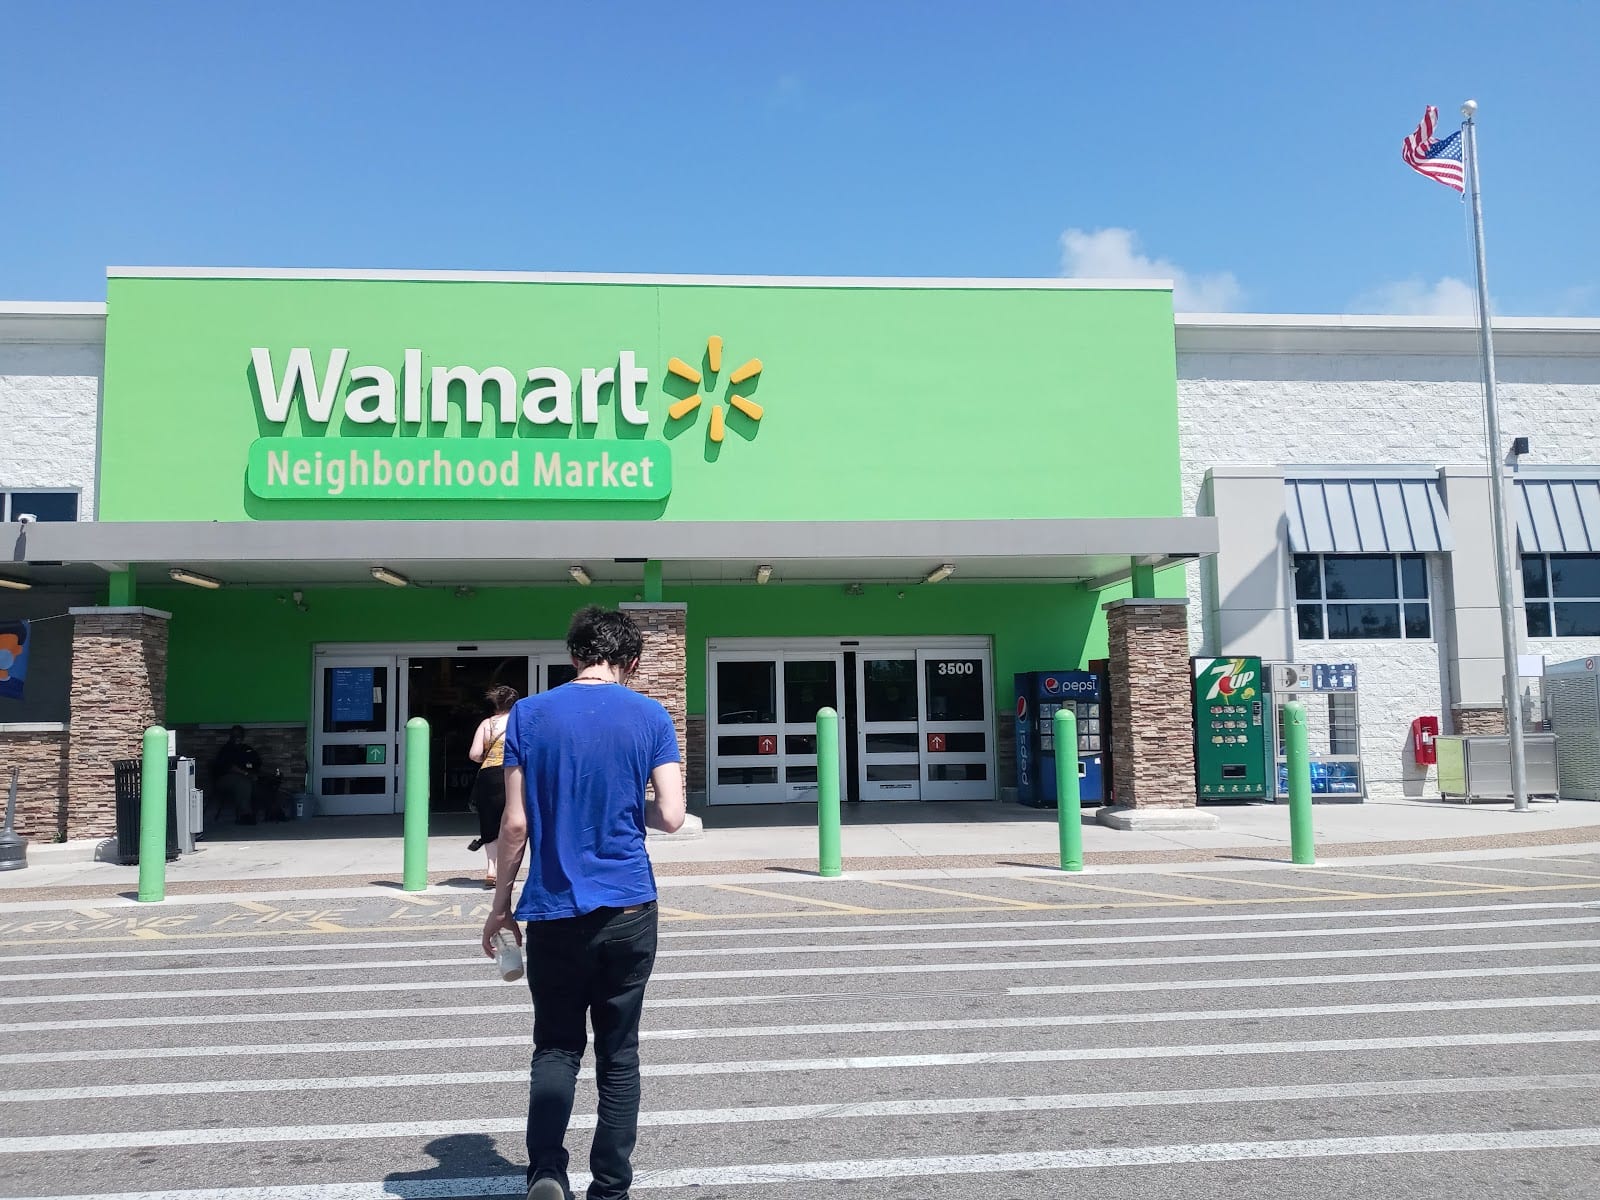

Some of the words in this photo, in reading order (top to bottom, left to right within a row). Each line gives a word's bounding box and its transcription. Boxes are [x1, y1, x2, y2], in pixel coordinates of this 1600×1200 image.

[251, 348, 649, 425] Walmart
[267, 450, 520, 495] Neighborhood
[533, 452, 655, 488] Market
[938, 662, 974, 676] 3500
[1062, 679, 1096, 692] pepsi
[1020, 730, 1029, 785] pepsi
[0, 914, 199, 934] RKING
[212, 907, 359, 926] FIRE
